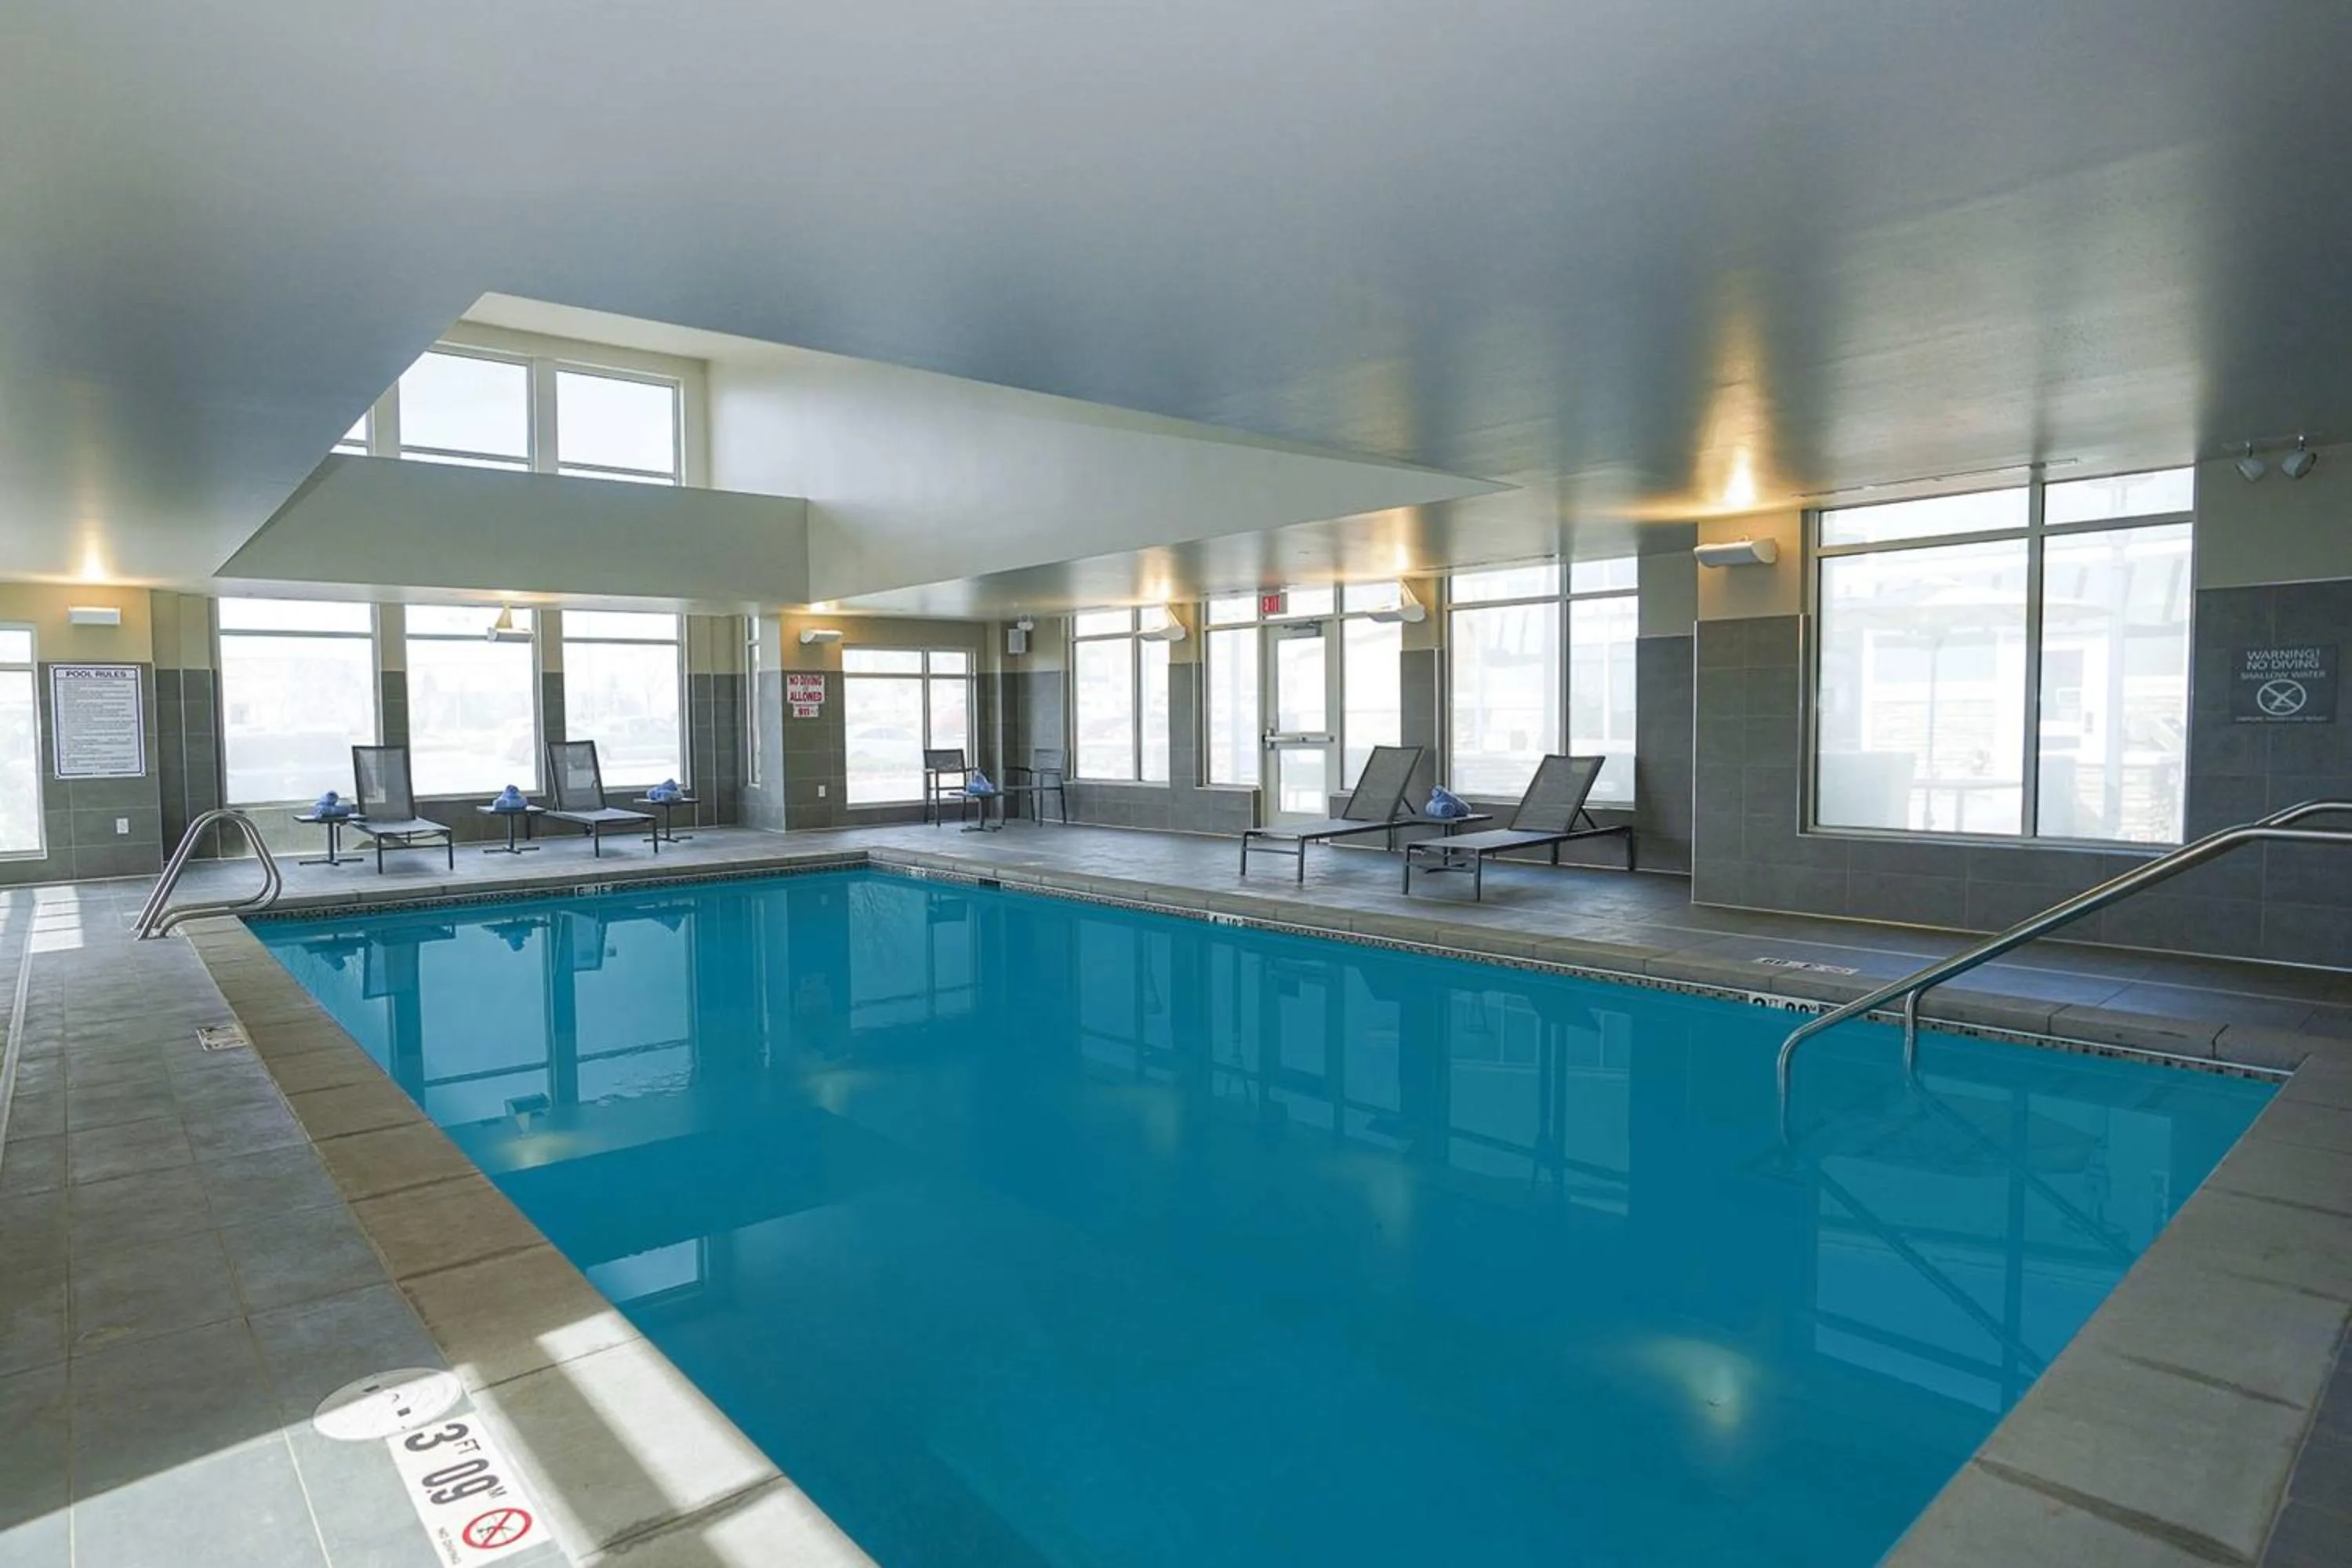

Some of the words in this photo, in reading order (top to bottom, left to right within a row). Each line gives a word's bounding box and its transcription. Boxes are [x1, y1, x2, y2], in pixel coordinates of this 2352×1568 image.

[1262, 595, 1279, 612] EXIT
[2246, 648, 2321, 660] WARNING!
[2246, 660, 2267, 670] NO
[2271, 659, 2319, 669] DIVING
[789, 677, 799, 685] NO
[2241, 671, 2289, 680] SHALLOW
[789, 691, 822, 702] ALLOWED
[405, 1423, 469, 1451] 3
[453, 1438, 482, 1456] FT
